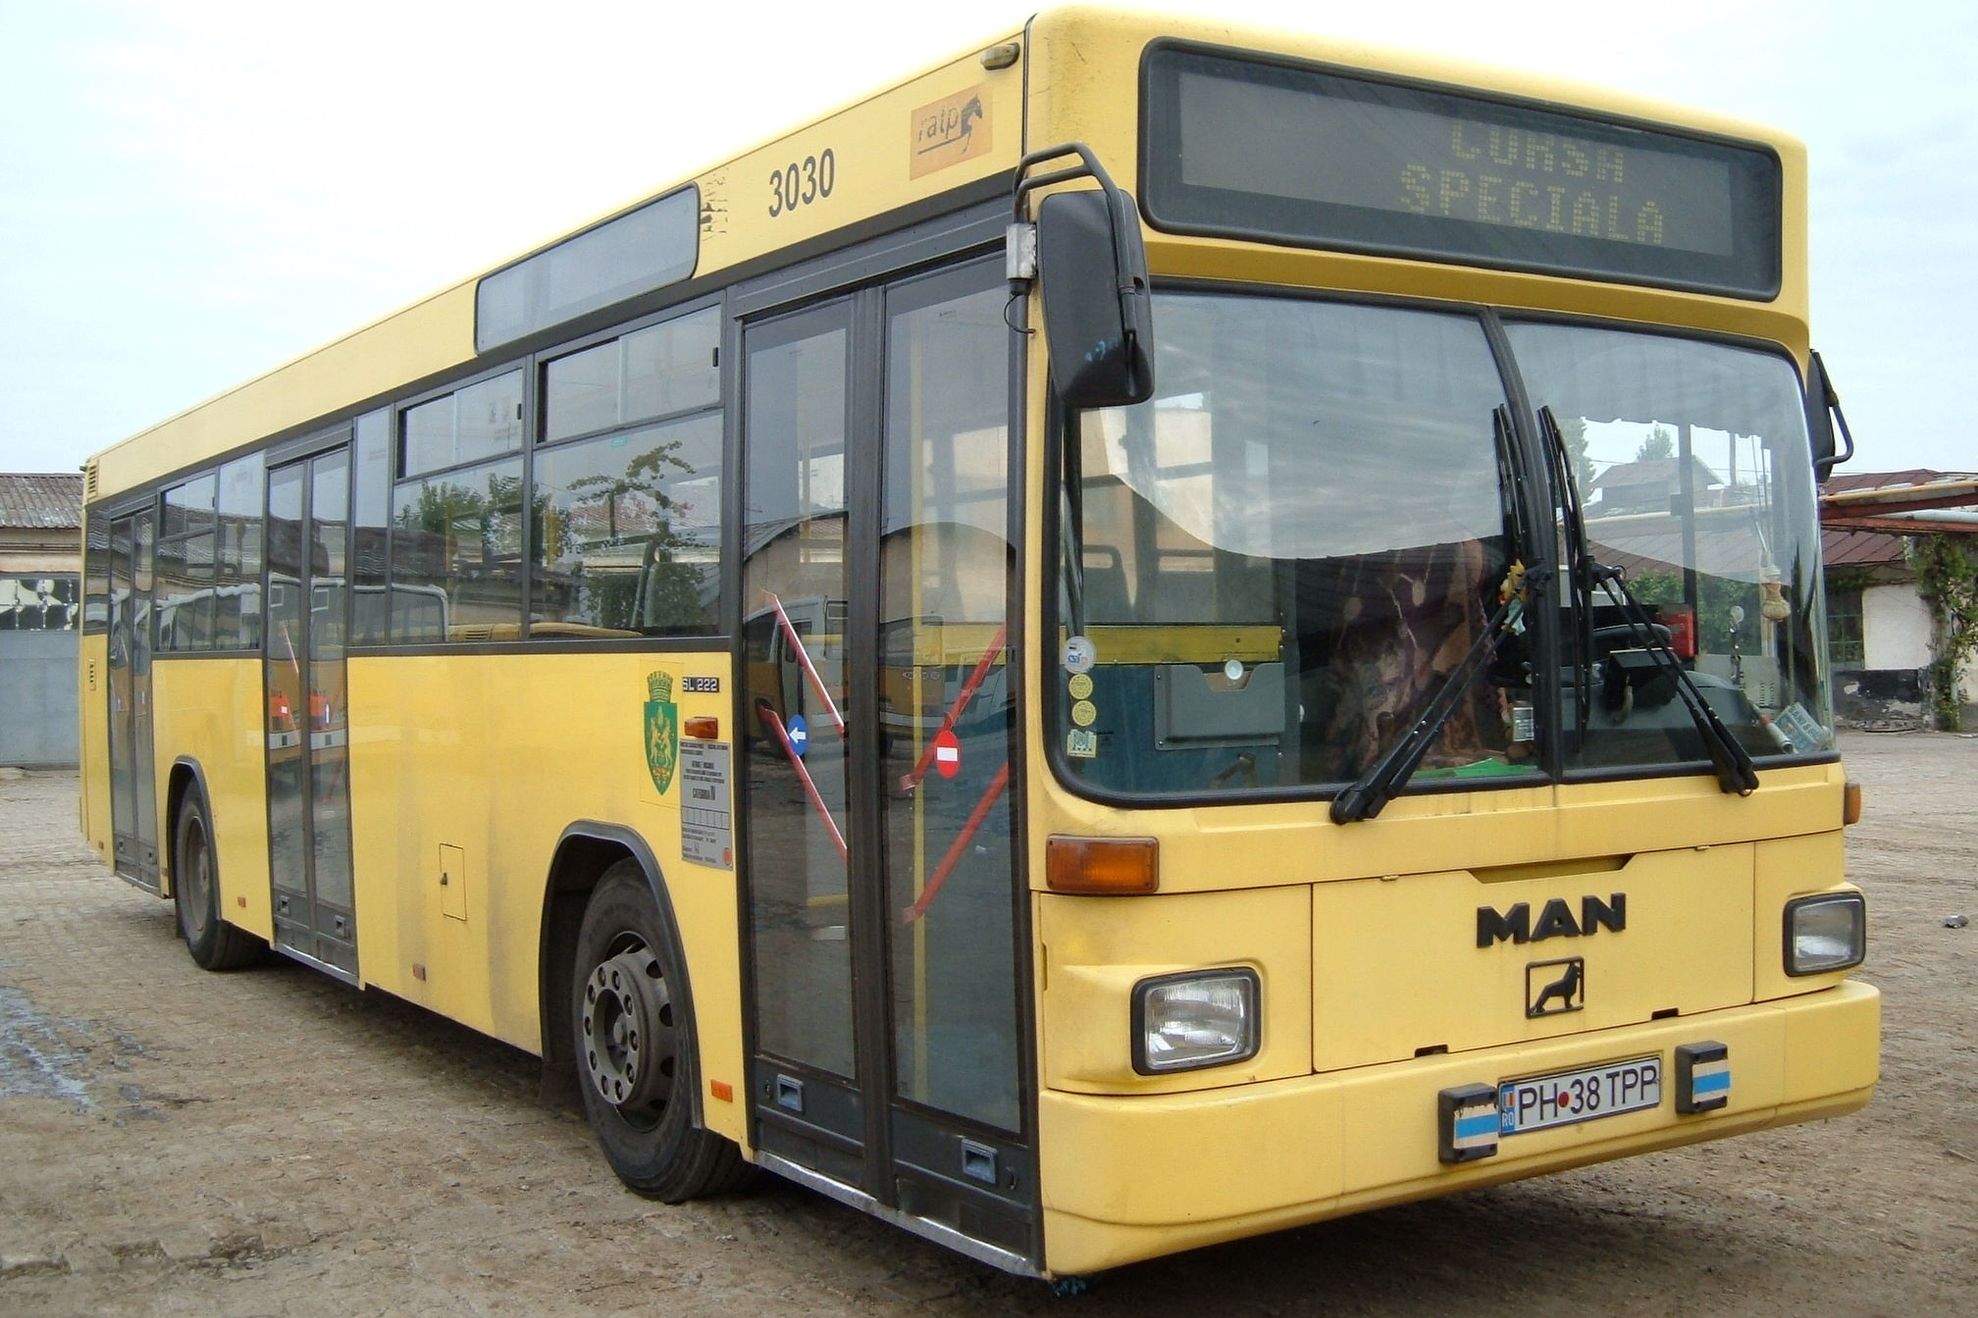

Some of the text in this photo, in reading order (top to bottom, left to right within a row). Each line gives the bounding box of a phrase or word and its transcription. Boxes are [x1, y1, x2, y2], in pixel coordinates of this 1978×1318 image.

[769, 148, 835, 217] 3030
[1401, 164, 1663, 244] SPECIALA
[696, 678, 718, 691] 222
[1477, 892, 1626, 948] MAN
[1502, 1065, 1657, 1127] RO PH 38 TPP
